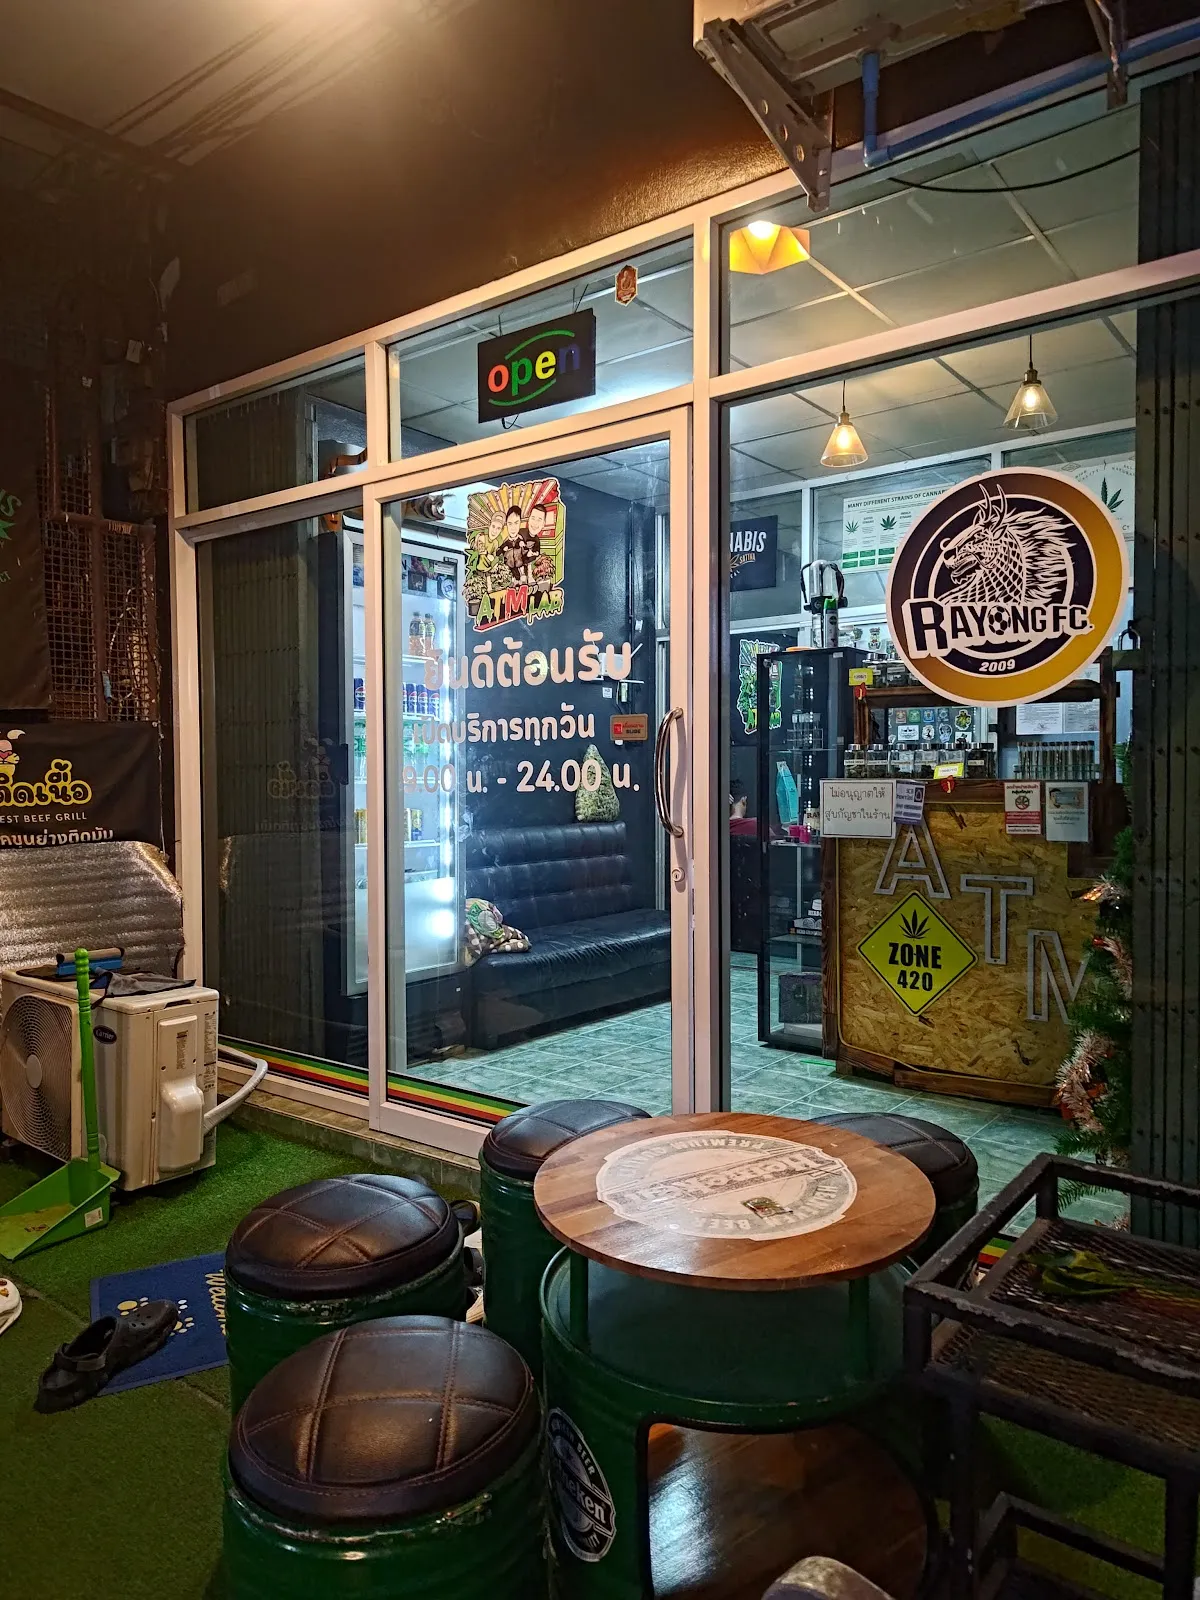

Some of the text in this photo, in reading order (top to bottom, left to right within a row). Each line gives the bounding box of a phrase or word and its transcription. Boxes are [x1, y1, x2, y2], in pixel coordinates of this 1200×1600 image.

[487, 343, 580, 397] open
[863, 497, 890, 507] DIFFERENT
[891, 494, 913, 503] STRAINS
[477, 585, 564, 627] ATM LAB
[424, 628, 632, 691] ยินดีต้อนรับ
[978, 658, 1016, 673] 2009
[413, 702, 596, 747] เปิดบริการทุกวัน
[402, 763, 456, 793] 9.00
[466, 769, 488, 793] น.
[516, 759, 602, 792] 24.00
[612, 762, 641, 792] น.
[23, 813, 51, 823] BEEF
[55, 811, 88, 822] GRILL
[824, 807, 891, 821] สูบกัญชาในร้าน
[888, 942, 942, 970] ZONE
[897, 970, 933, 992] 420
[576, 1440, 597, 1476] BEER
